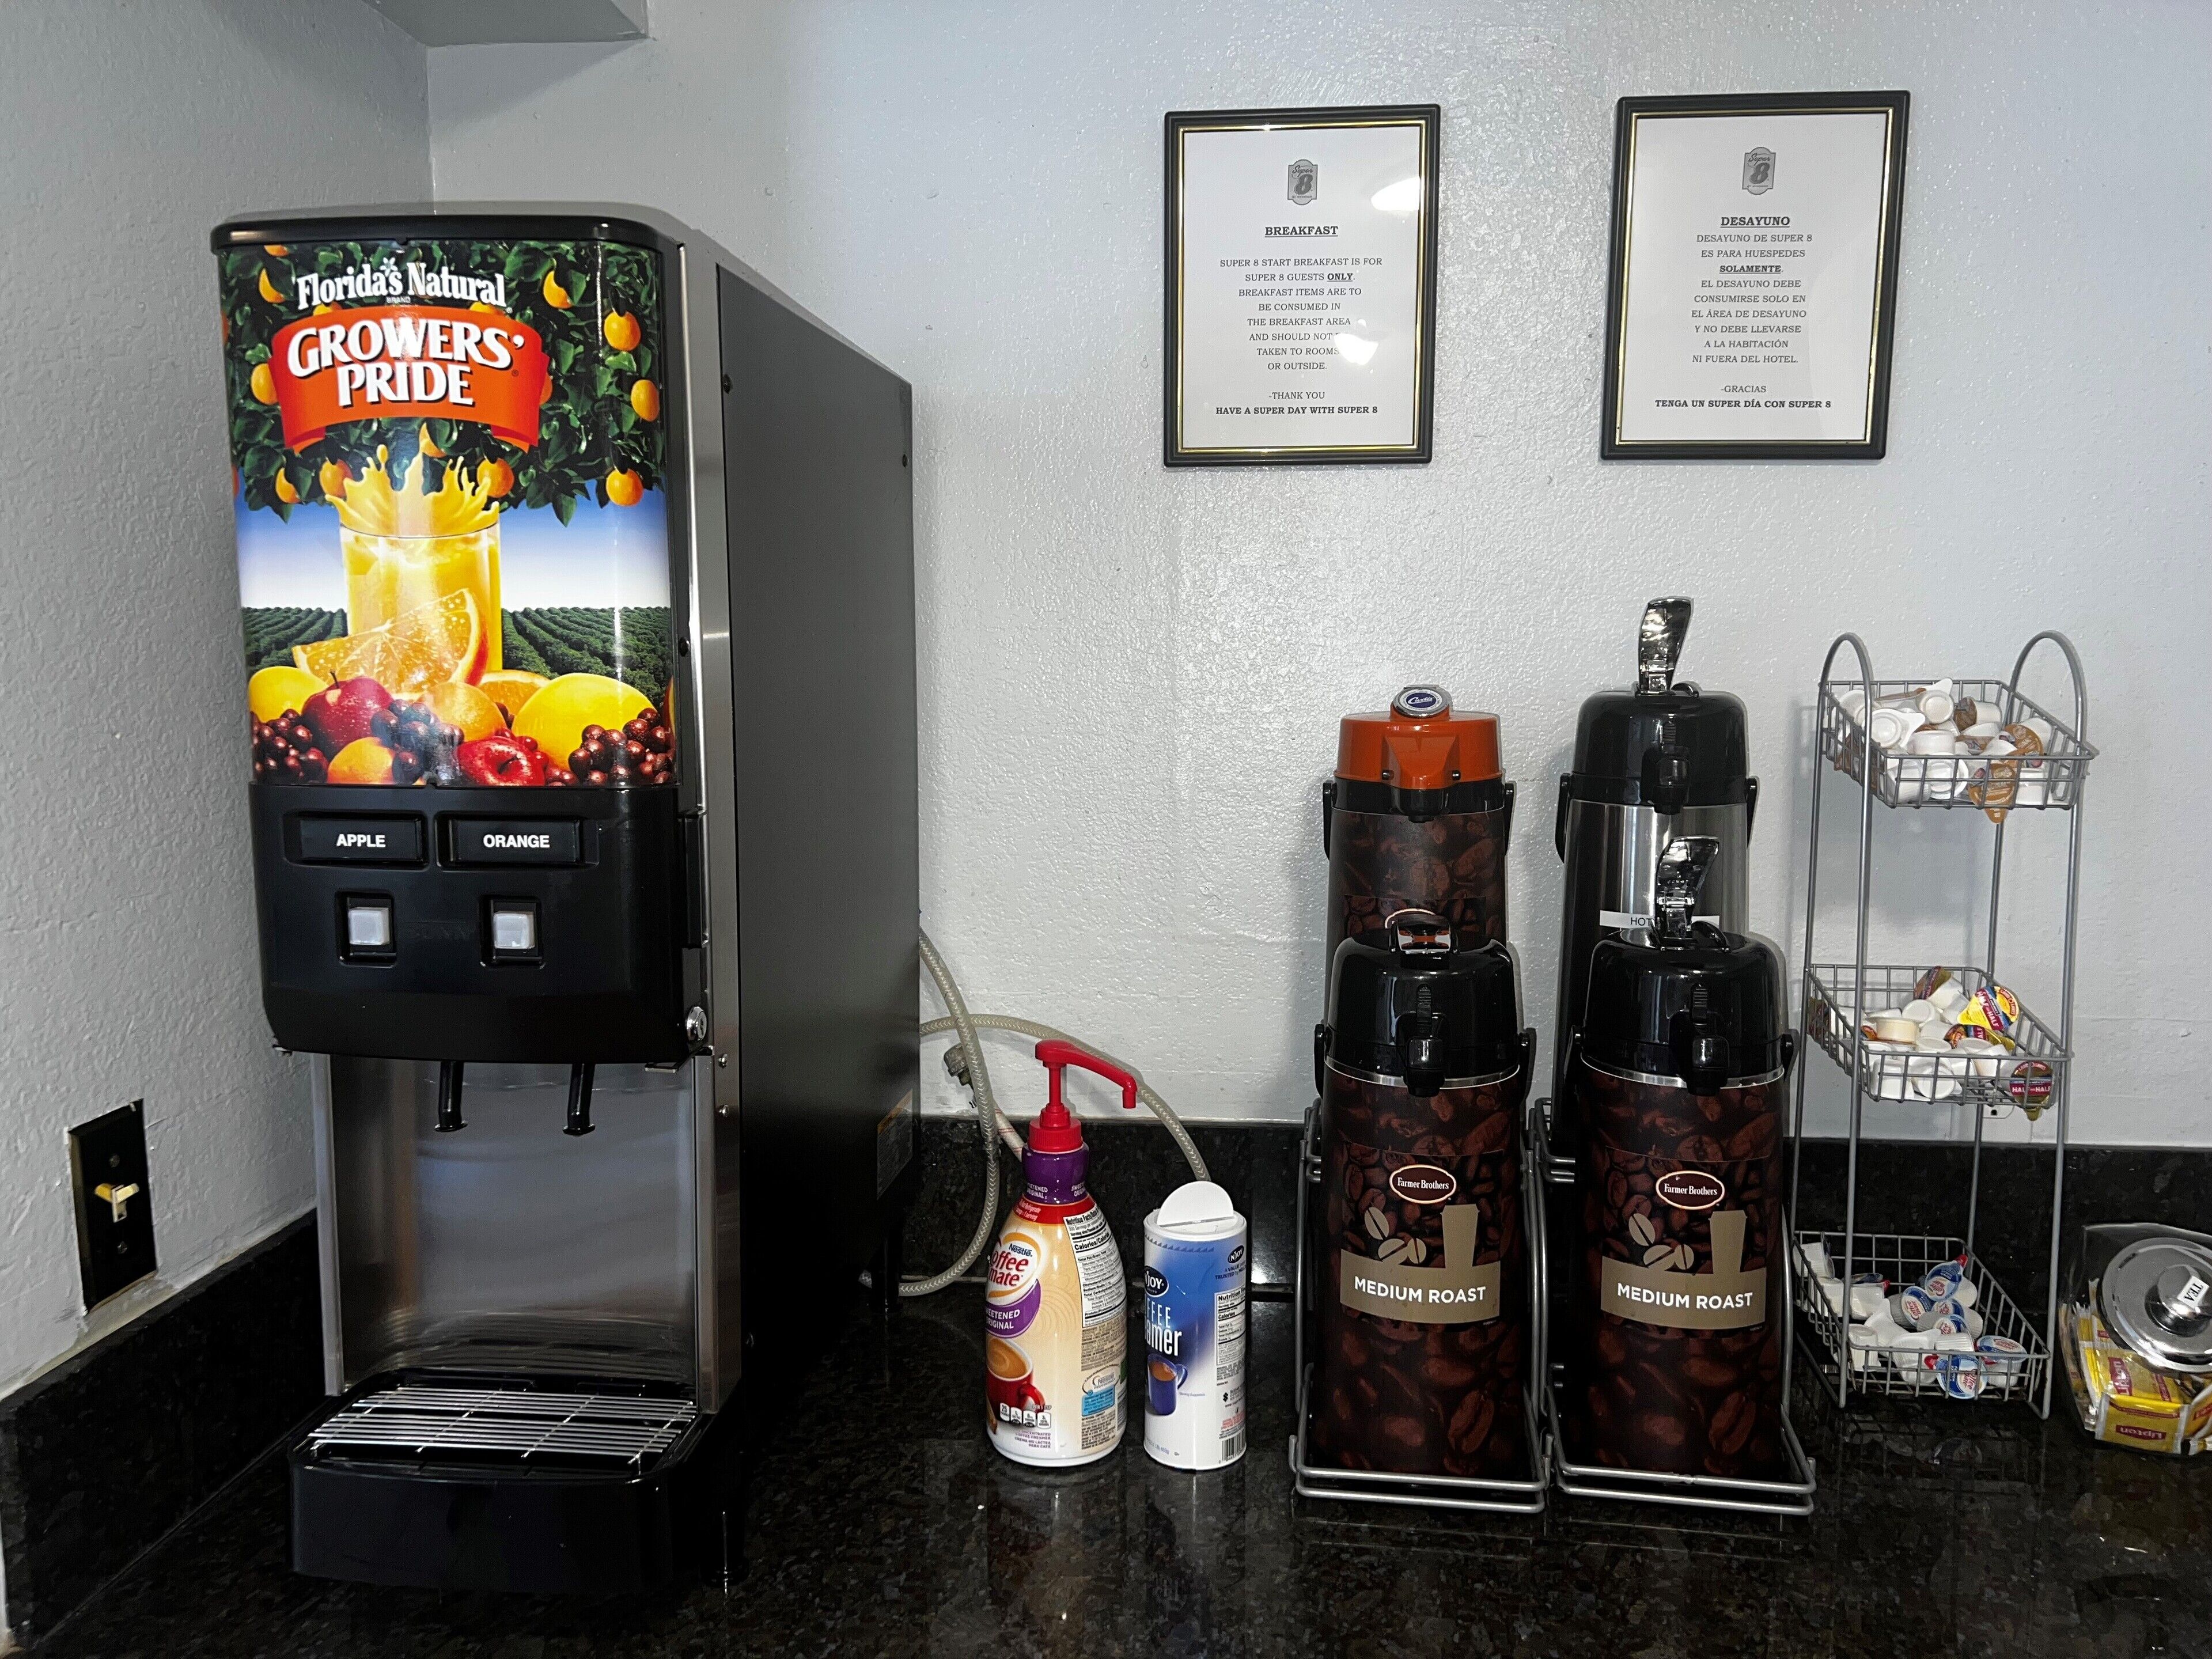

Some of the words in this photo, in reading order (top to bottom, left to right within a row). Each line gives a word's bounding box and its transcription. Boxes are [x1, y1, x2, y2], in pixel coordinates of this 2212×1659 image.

[1749, 162, 1771, 184] 8
[1294, 173, 1313, 195] 8
[1719, 216, 1791, 229] DESAYUNO
[1264, 225, 1339, 238] BREAKFAST
[1696, 234, 1751, 243] DESAYUNO
[1753, 234, 1768, 243] DE
[1770, 234, 1804, 243] SUPER
[1806, 234, 1813, 242] 8
[1700, 249, 1714, 258] ES
[1717, 249, 1742, 258] PARA
[1744, 249, 1805, 258] HUESPEDES
[1219, 259, 1251, 267] SUPER
[1253, 259, 1259, 267] 8
[1262, 258, 1291, 267] START
[1293, 257, 1349, 267] BREAKFAST
[1351, 257, 1361, 266] IS
[1363, 257, 1382, 266] FOR
[1245, 273, 1276, 282] SUPER
[1278, 273, 1285, 282] 8
[1287, 272, 1325, 281] GUESTS
[1327, 272, 1355, 282] ONLY.
[297, 263, 402, 310] Florida's
[406, 262, 507, 307] Natural
[1700, 280, 1714, 288] EL
[1715, 280, 1770, 288] DESAYUNO
[1773, 279, 1801, 288] DEBE
[1238, 288, 1294, 297] BREAKFAST
[1296, 287, 1324, 296] ITEMS
[1327, 287, 1347, 296] ARE
[1349, 287, 1362, 296] TO
[1694, 295, 1760, 303] CONSUMIRSE
[1762, 295, 1790, 303] SOLO
[1792, 295, 1806, 303] EN
[1258, 303, 1272, 311] BE
[1274, 302, 1328, 311] CONSUMED
[1331, 302, 1341, 310] IN
[1691, 310, 1704, 318] EL
[1706, 308, 1733, 318] ÁREA
[1735, 310, 1749, 318] DE
[1752, 309, 1807, 318] DESAYUNO
[1247, 318, 1267, 326] THE
[1268, 317, 1324, 326] BREAKFAST
[1325, 317, 1351, 325] AREA
[1695, 325, 1701, 333] Y
[1703, 325, 1718, 333] NO
[1720, 325, 1748, 334] DEBE
[1751, 325, 1801, 334] LLEVARSE
[1249, 333, 1269, 341] AND
[1271, 333, 1310, 341] SHOULD
[1313, 332, 1333, 340] NOT
[288, 317, 524, 378] GROWERS'
[1704, 340, 1711, 348] A
[1714, 340, 1726, 348] LA
[1728, 339, 1789, 349] HABITACIÓN
[1256, 347, 1287, 356] TAKEN
[1289, 347, 1302, 355] TO
[1692, 355, 1702, 363] NI
[1705, 355, 1738, 363] FUERA
[1740, 355, 1761, 363] DEL
[1763, 355, 1798, 363] HOTEL.
[1267, 362, 1281, 370] OR
[1283, 362, 1328, 370] OUTSIDE.
[337, 361, 475, 407] PRIDE
[1721, 385, 1767, 393] -GRACIAS
[1268, 392, 1303, 400] -THANK
[1305, 391, 1325, 399] YOU
[1654, 399, 1688, 407] TENGA
[1691, 400, 1706, 408] UN
[1707, 400, 1741, 408] SUPER
[1743, 398, 1762, 408] DÍA
[1764, 400, 1786, 408] CON
[1788, 400, 1823, 408] SUPER
[1825, 400, 1831, 408] 8
[1215, 407, 1242, 415] HAVE
[1244, 407, 1251, 415] A
[1253, 407, 1285, 415] SUPER
[1287, 406, 1308, 414] DAY
[1309, 406, 1335, 414] WITH
[1337, 406, 1370, 414] SUPER
[1372, 406, 1378, 414] 8
[336, 834, 387, 848] APPLE
[483, 834, 551, 849] ORANGE
[1630, 917, 1653, 926] HOT
[1397, 1177, 1420, 1189] Farmer
[1421, 1179, 1449, 1190] Brothers
[1664, 1183, 1688, 1194] Farmer
[1688, 1185, 1718, 1195] Brothers
[990, 1247, 1029, 1272] offee
[989, 1267, 1020, 1286] mate
[1354, 1276, 1422, 1302] MEDIUM
[1429, 1286, 1486, 1304] ROAST
[2184, 1283, 2204, 1301] TEA
[1218, 1290, 1240, 1302] Nutrition
[1617, 1282, 1690, 1308] MEDIUM
[1696, 1292, 1753, 1309] ROAST
[2119, 1426, 2162, 1439] Lipton
